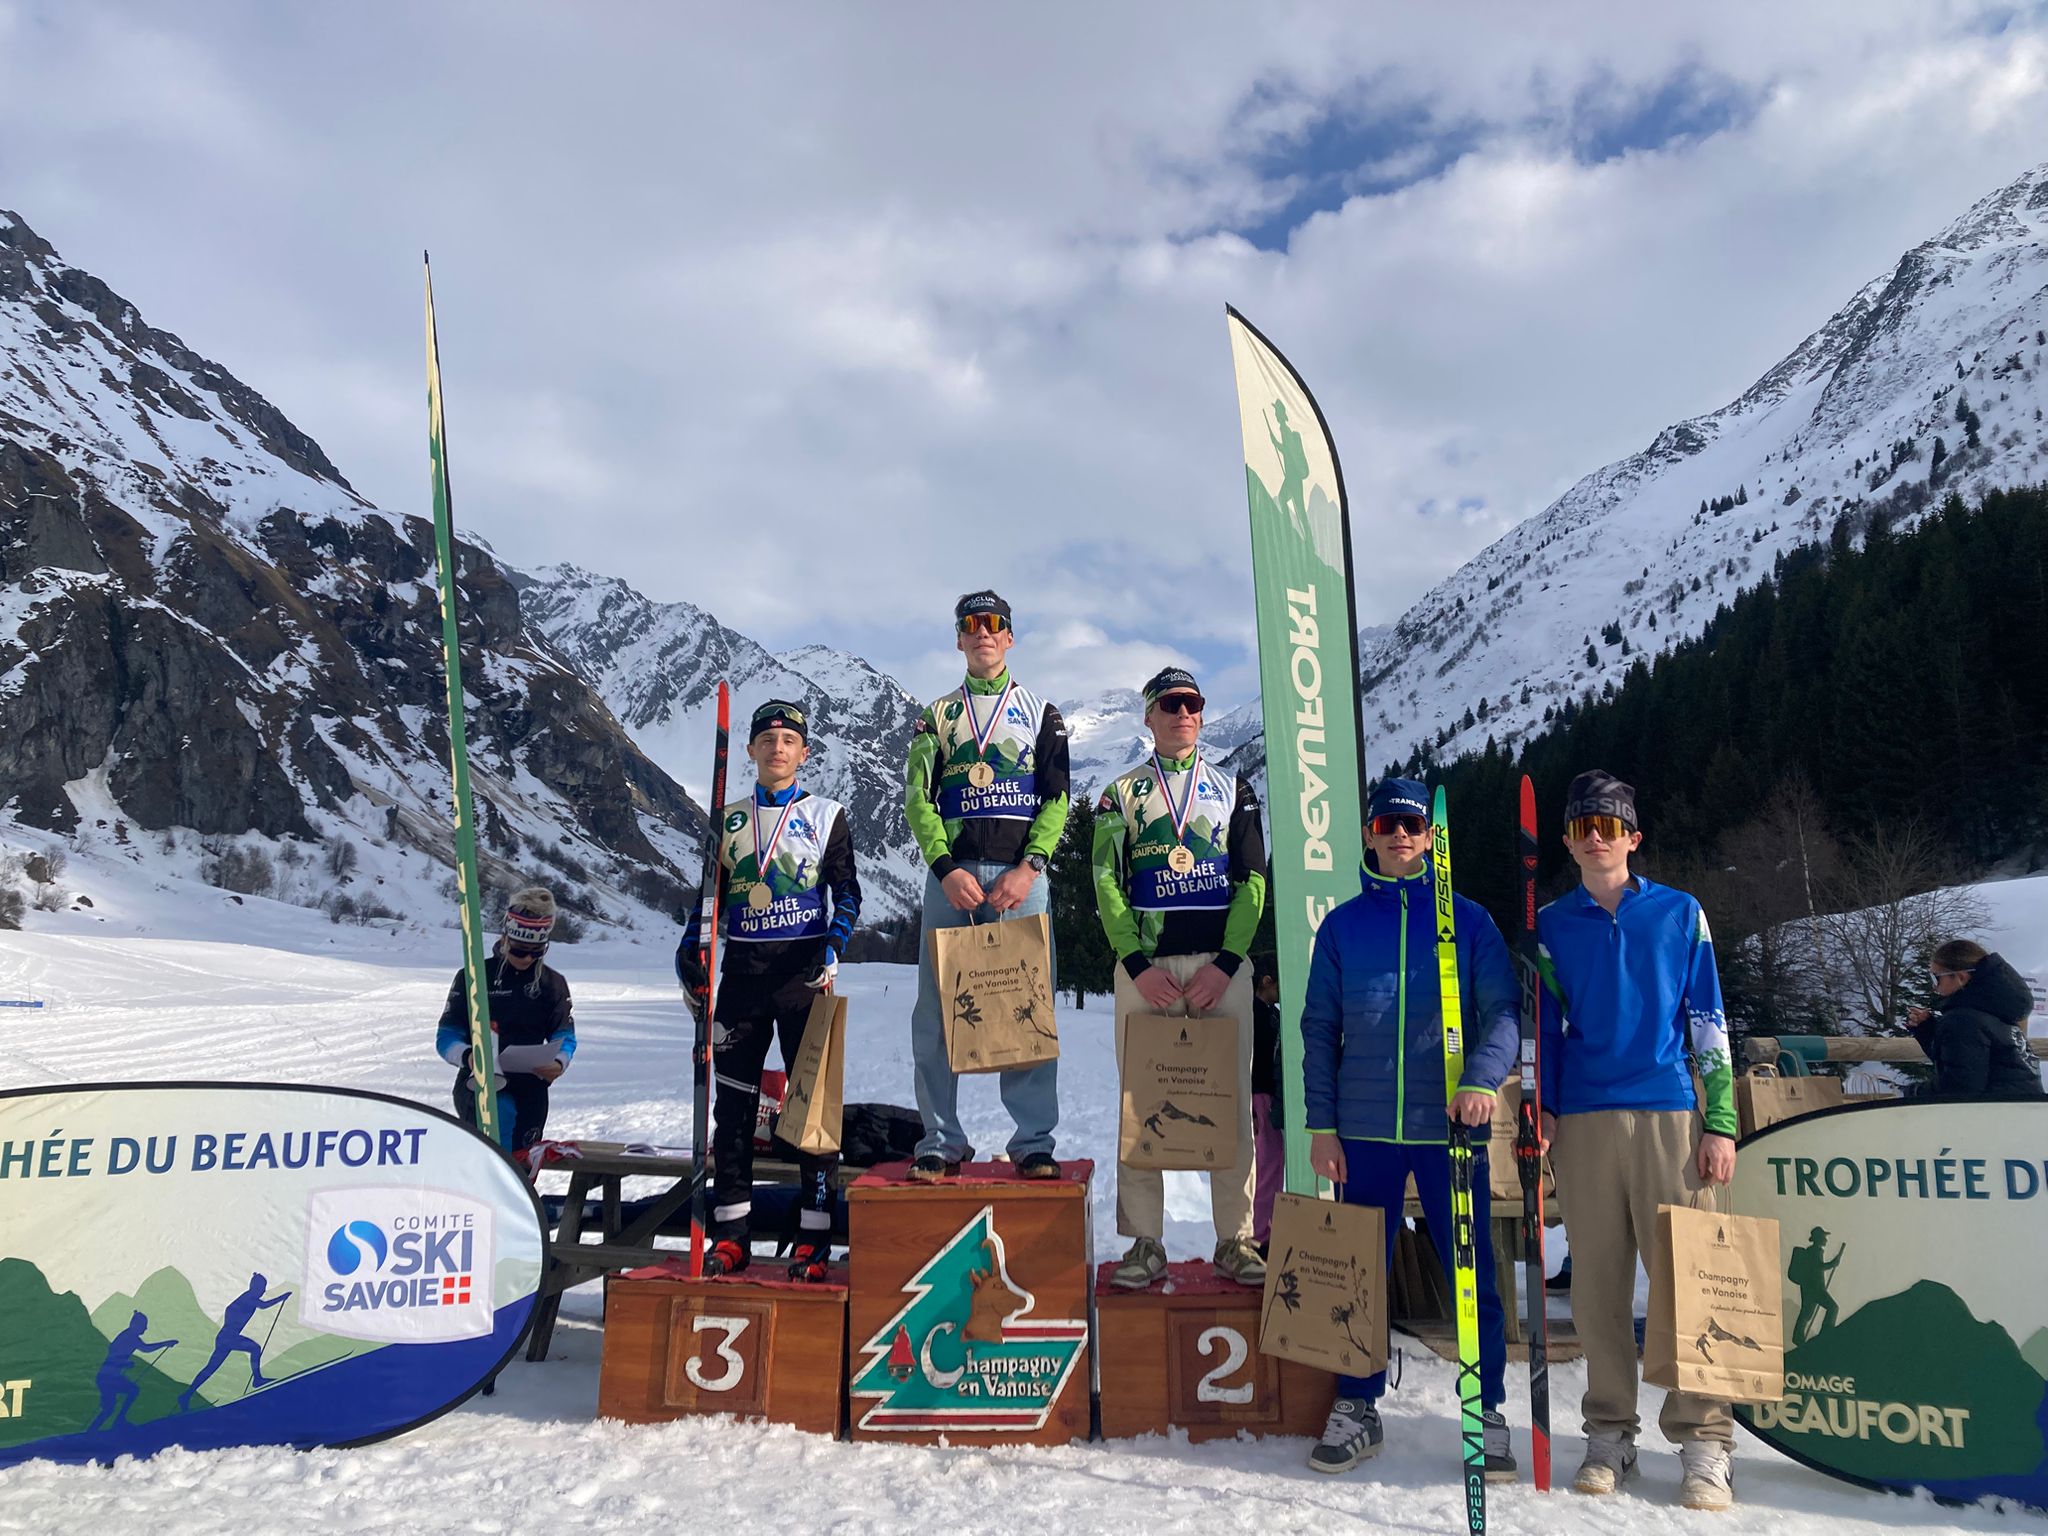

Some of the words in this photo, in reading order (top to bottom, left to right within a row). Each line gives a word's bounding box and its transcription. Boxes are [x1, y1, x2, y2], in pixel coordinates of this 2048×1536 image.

[961, 798, 980, 813] DU
[730, 813, 743, 831] 3
[1175, 853, 1187, 865] 2
[1435, 824, 1451, 918] FISCHER
[1156, 883, 1176, 898] DU
[741, 917, 758, 932] DU
[969, 966, 1020, 979] Champagny
[973, 982, 983, 990] en
[985, 978, 1019, 988] Vanoise
[1156, 1063, 1208, 1075] Champagny
[1172, 1076, 1206, 1085] Vanoise
[107, 1136, 177, 1175] DU
[191, 1128, 428, 1172] BEAUFORT
[1767, 1148, 1991, 1200] TROPHÉE
[394, 1214, 474, 1230] COMITE
[391, 1230, 473, 1274] SKI
[1299, 1251, 1349, 1268] Champagny
[1300, 1267, 1311, 1275] en
[1313, 1267, 1346, 1281] Vanoise
[1698, 1270, 1749, 1287] Champagny
[322, 1279, 439, 1312] SAVOIE
[1702, 1287, 1711, 1295] en
[1712, 1286, 1748, 1300] Vanoise
[685, 1317, 749, 1391] 3
[921, 1321, 1062, 1389] Champagny
[1196, 1326, 1255, 1404] 2
[958, 1381, 979, 1397] en
[982, 1374, 1052, 1397] Vanoise
[1783, 1373, 1855, 1394] OMAGE
[1752, 1395, 1970, 1449] BEAUFORT
[1469, 1474, 1483, 1530] SPEED
